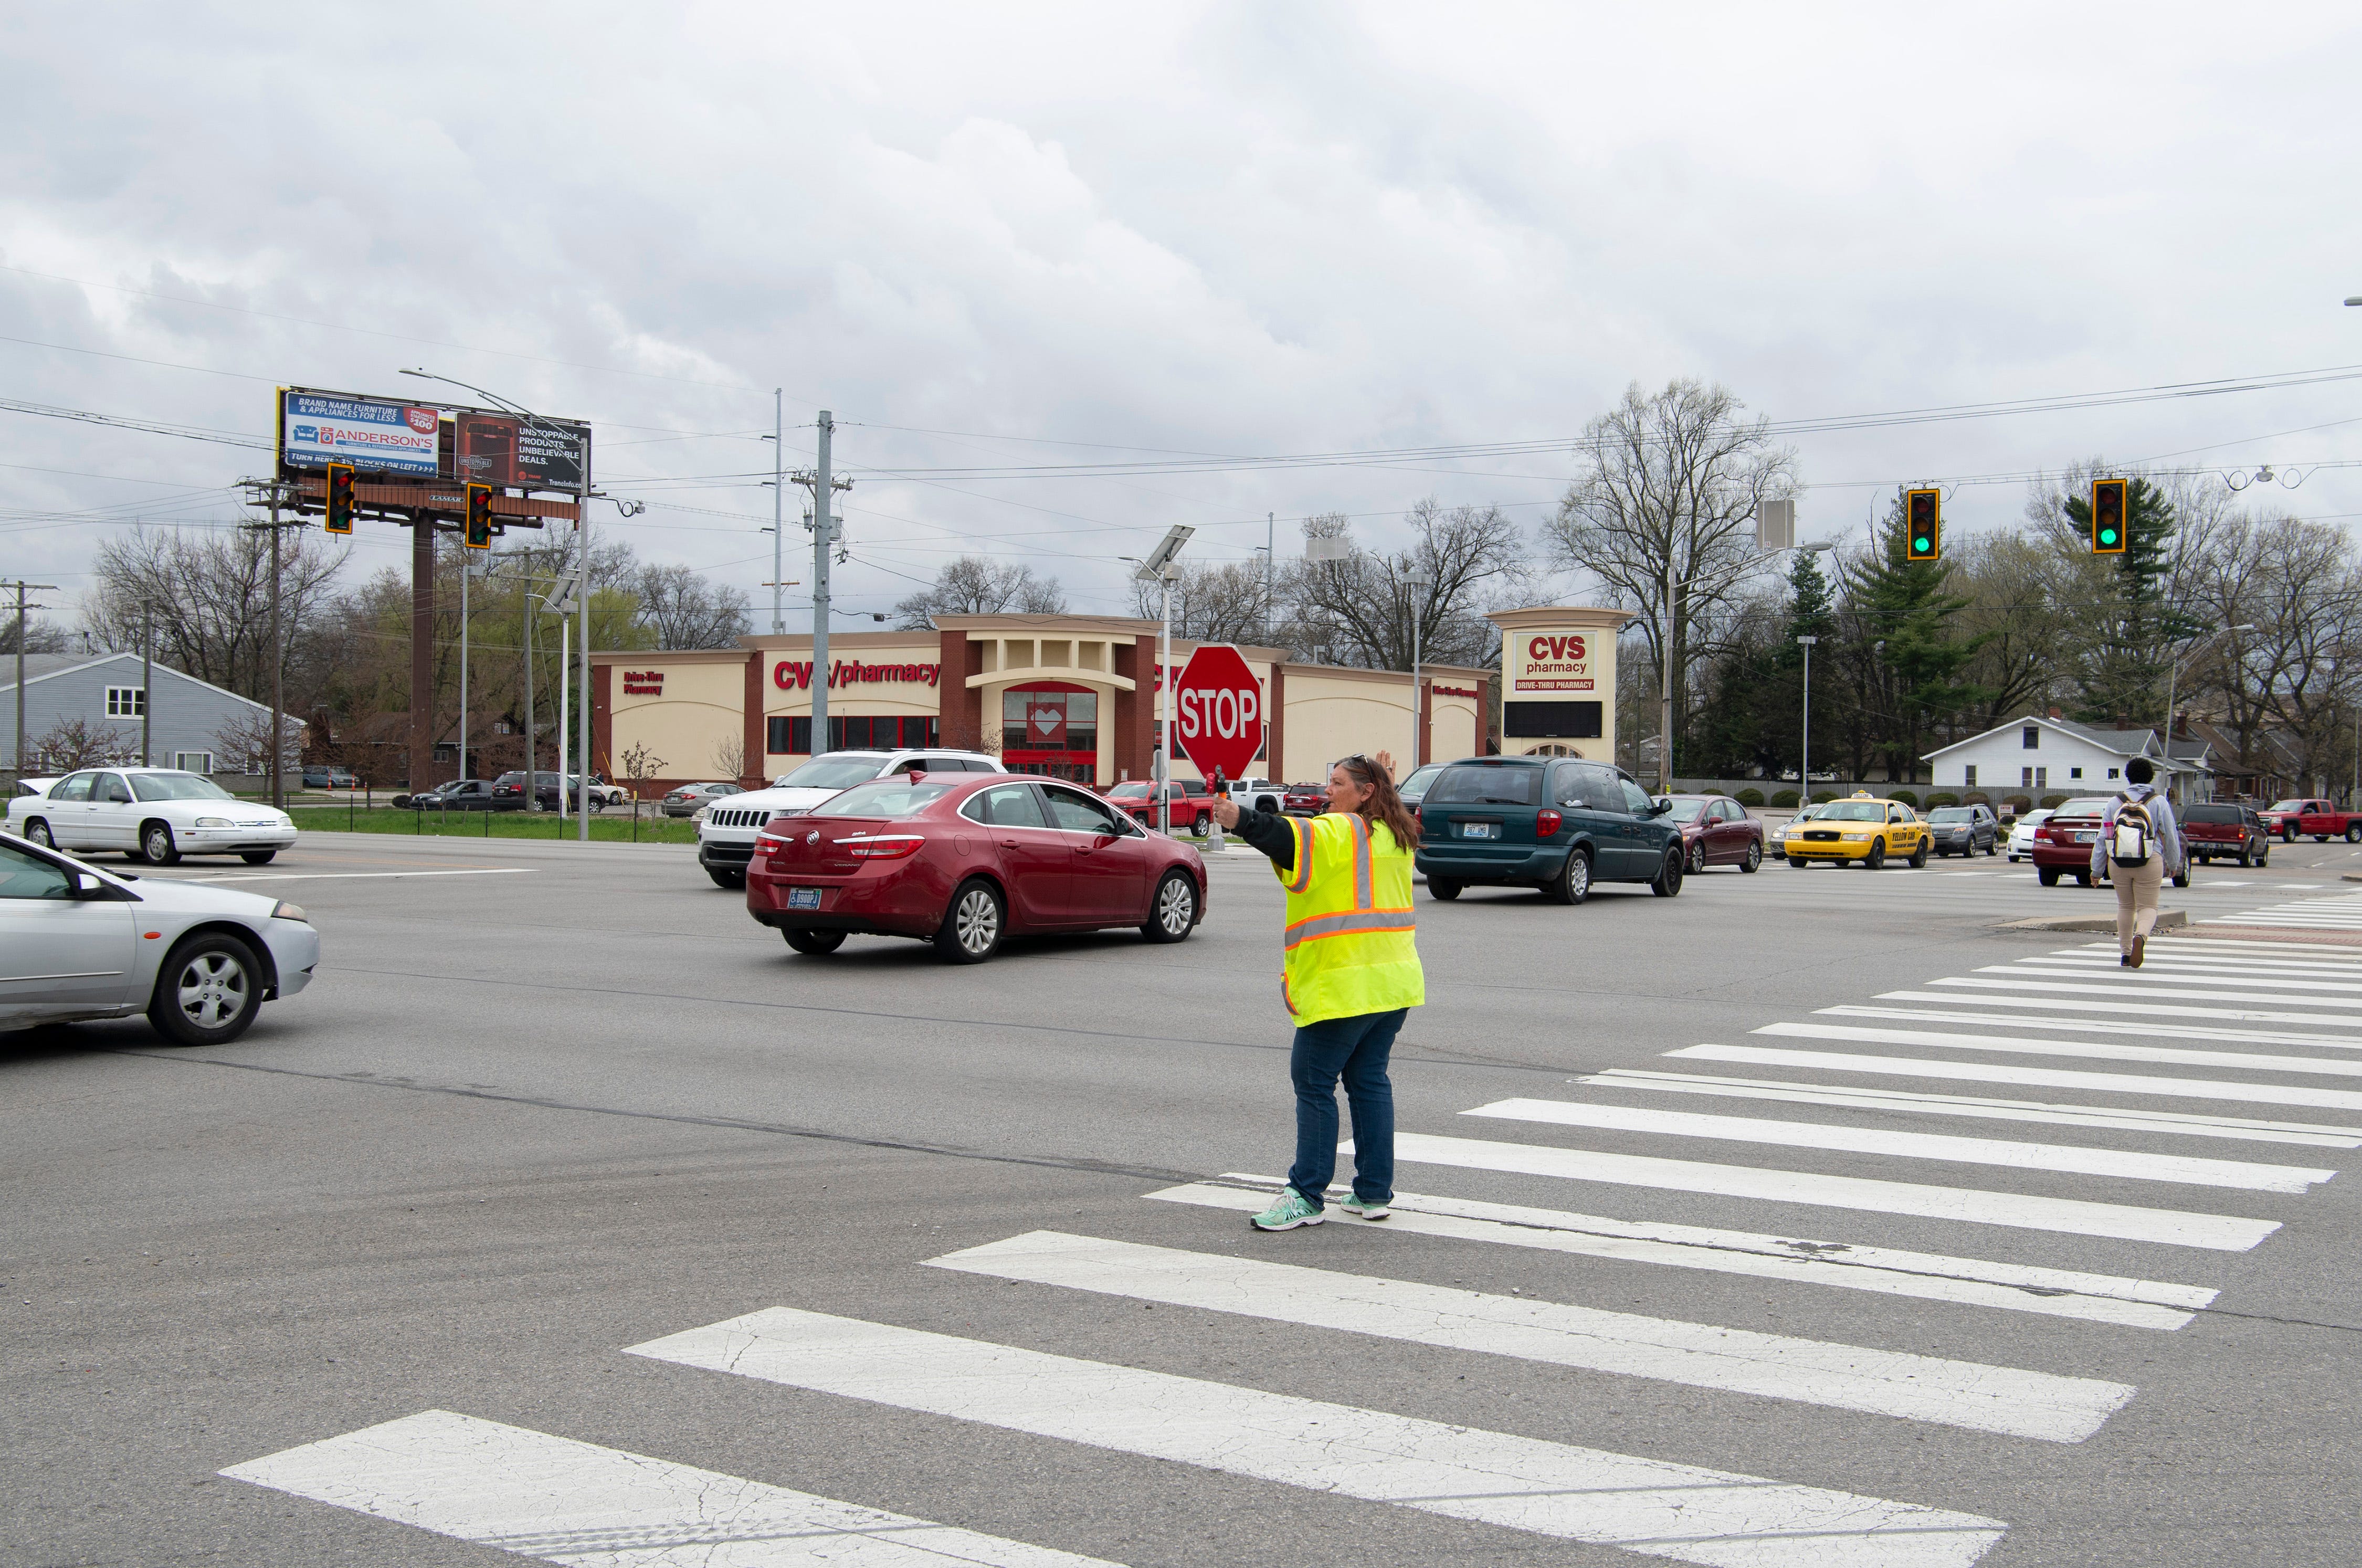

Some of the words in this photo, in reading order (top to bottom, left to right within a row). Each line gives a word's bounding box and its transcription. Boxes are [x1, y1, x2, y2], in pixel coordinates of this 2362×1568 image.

[299, 398, 326, 407] BRAND
[329, 401, 352, 411] NAME
[354, 404, 398, 416] FURNITURE
[308, 406, 357, 418] APPLIANCES
[410, 410, 435, 420] APPLIANCES
[410, 417, 433, 430] $100
[335, 430, 433, 448] ANDERSON'S
[519, 437, 566, 449] PRODUCTS.
[519, 446, 579, 459] UNBELIEVABLE
[355, 458, 386, 468] BLOCKS
[399, 462, 418, 471] LEFT
[519, 455, 548, 465] DEALS.
[549, 479, 582, 488] TraneInfo.co
[1529, 636, 1586, 660] CVS
[774, 659, 941, 689] CV/pharmacy
[1526, 661, 1587, 675] pharmacy
[624, 671, 663, 682] Drive-Thru
[624, 684, 662, 696] Pharmacy
[1181, 688, 1257, 739] STOP
[1892, 832, 1907, 841] YELLOW
